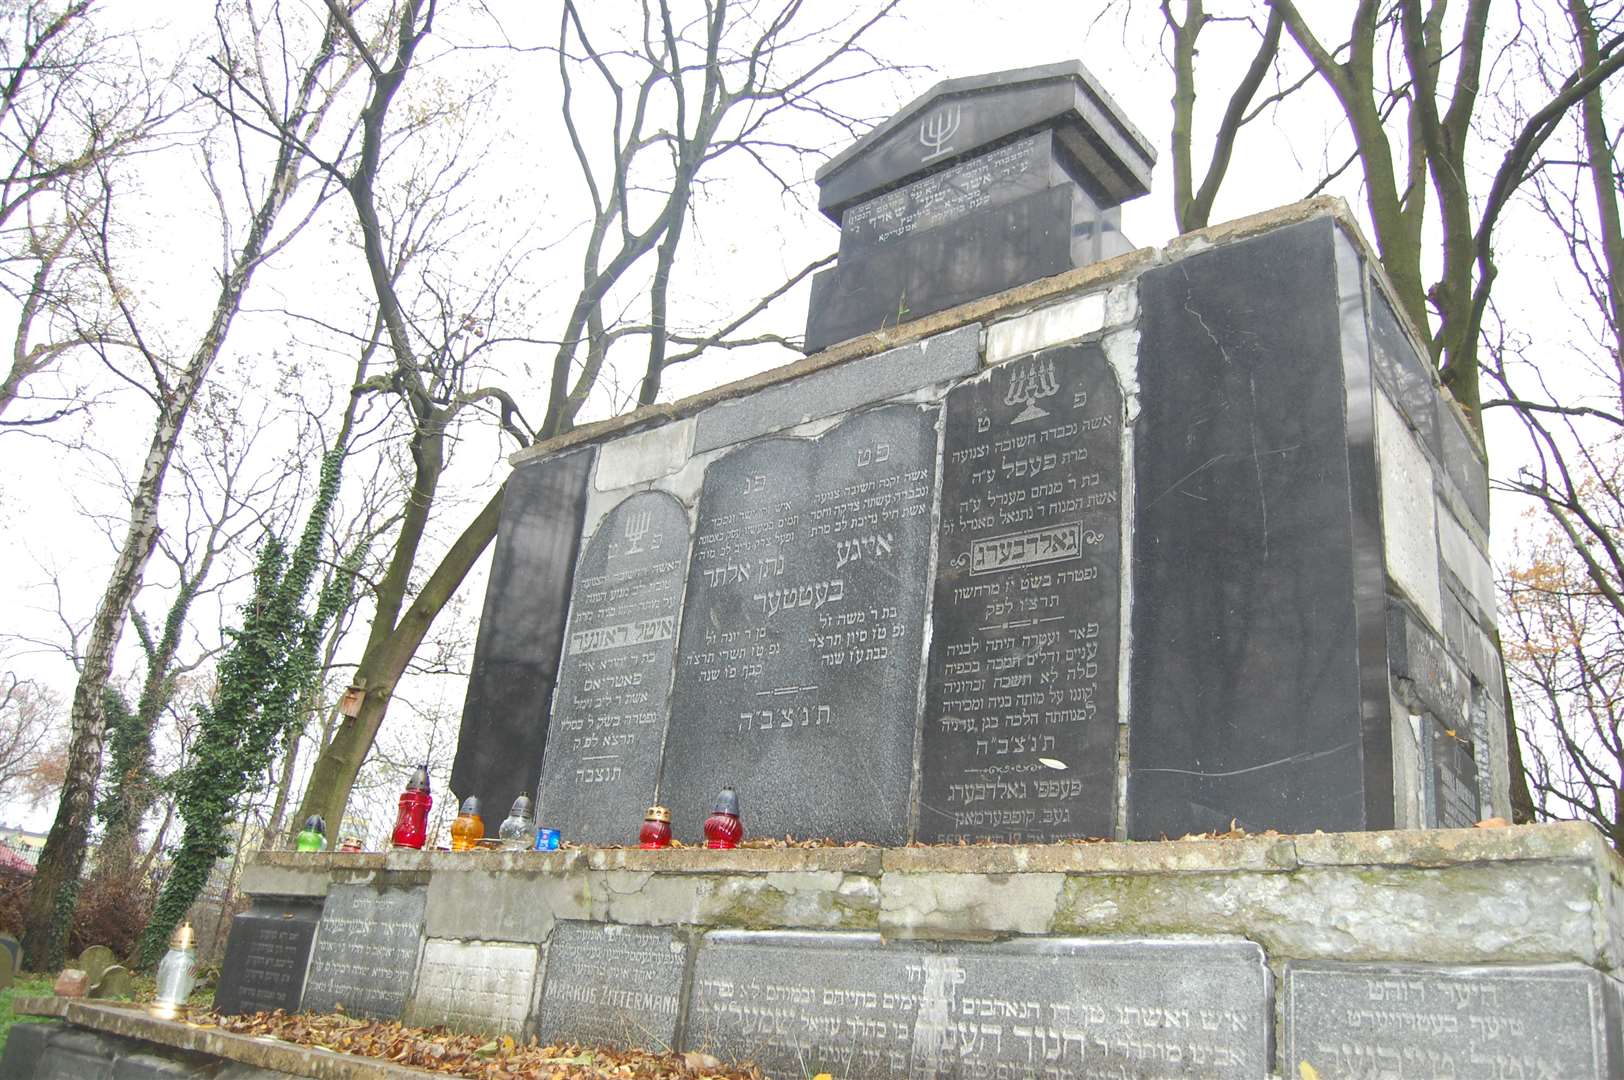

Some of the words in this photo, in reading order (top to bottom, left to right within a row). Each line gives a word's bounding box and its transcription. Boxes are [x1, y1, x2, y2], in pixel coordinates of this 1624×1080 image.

[1083, 414, 1111, 430] אשה
[1040, 423, 1077, 441] נכבדה
[995, 432, 1035, 452] חשובה
[952, 444, 989, 464] וצנועה
[1061, 447, 1086, 463] מרת
[904, 468, 927, 483] אשה
[1000, 453, 1057, 480] פעסל
[844, 481, 874, 496] חשובה
[1081, 472, 1099, 487] בת
[987, 484, 1025, 508] מענדל
[1031, 481, 1062, 498] מנחם
[1088, 491, 1115, 505] אשת
[775, 501, 791, 512] איש
[833, 501, 859, 520] צדקה
[882, 505, 898, 521] חיל
[901, 502, 925, 517] אשת
[1048, 498, 1082, 514] המנוח
[778, 515, 796, 527] תמים
[834, 514, 847, 532] לב
[851, 513, 877, 528] נדיבת
[719, 542, 730, 556] לב
[975, 528, 1078, 567] גאלדבערג
[703, 555, 751, 588] אלתר
[758, 553, 785, 583] נתן
[1057, 567, 1096, 583] נפטרה
[753, 578, 845, 617] בעטטער
[953, 583, 999, 604] מרחשון
[837, 611, 864, 626] משה
[881, 605, 897, 619] בת
[720, 628, 739, 645] יונה
[846, 631, 867, 646] סיון
[1069, 621, 1098, 640] פאר
[946, 637, 979, 657] לבניה
[985, 637, 1014, 651] היתה
[1022, 630, 1059, 650] ועטרה
[719, 643, 746, 667] תשרי
[821, 651, 843, 667] שנה
[987, 653, 1020, 670] תמכה
[1027, 646, 1059, 665] ודלים
[1066, 643, 1097, 663] עניים
[945, 660, 979, 675] בכפיה
[1041, 666, 1057, 683] לא
[1067, 660, 1097, 680] סלה
[624, 690, 648, 705] אשת
[1016, 692, 1043, 706] מותה
[1049, 685, 1063, 704] על
[1070, 682, 1095, 702] יקוננו
[988, 694, 1011, 709] בניה
[1005, 706, 1038, 728] הלכה
[1044, 703, 1097, 724] למנוחתה
[981, 717, 997, 732] בגן
[947, 775, 1027, 806] גאלדבערג
[546, 979, 597, 1002] MARKUS
[599, 986, 678, 1013] ZITTERMANN
[740, 978, 759, 999] לא
[767, 981, 814, 1003] ובמותם
[823, 988, 875, 1007] בחייהם
[963, 998, 1039, 1020] הנאהבים
[1118, 1006, 1189, 1027] ואשתו
[1203, 1010, 1246, 1032] איש
[1013, 1026, 1085, 1060] חנוך
